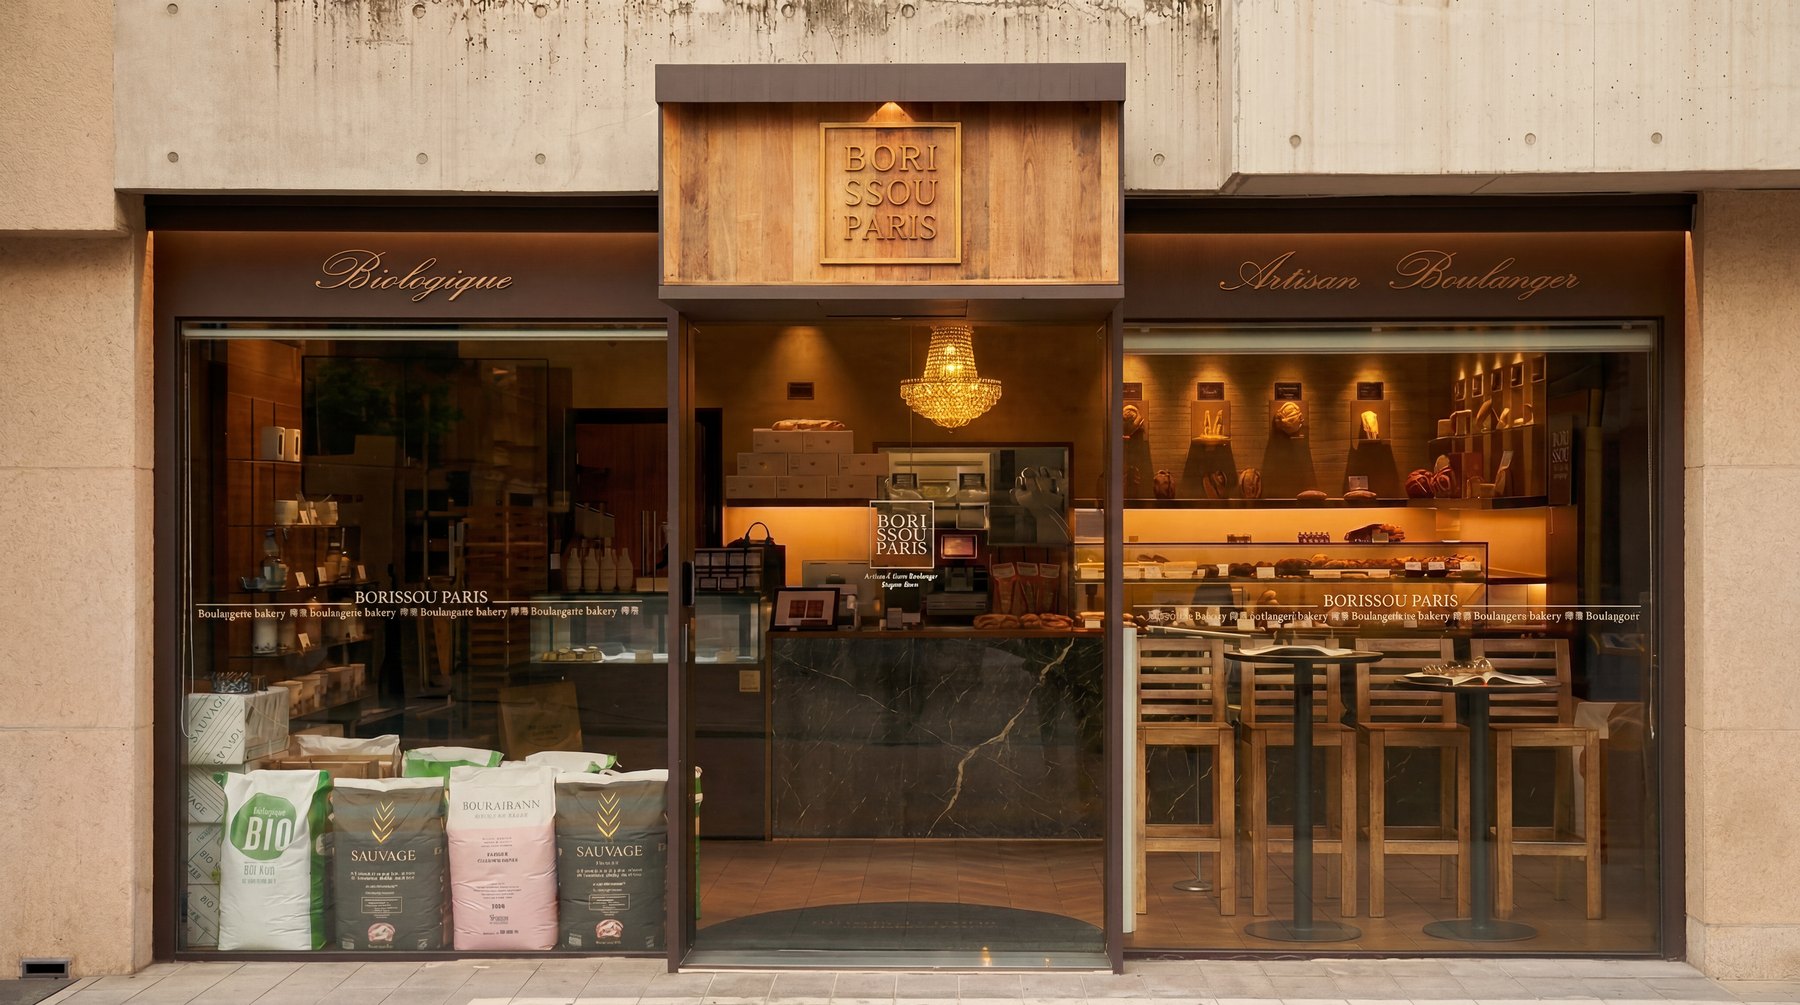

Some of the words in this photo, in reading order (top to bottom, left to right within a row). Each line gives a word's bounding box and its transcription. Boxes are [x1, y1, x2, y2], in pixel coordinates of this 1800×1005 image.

[844, 145, 937, 172] BORI
[844, 179, 938, 206] SSOU
[844, 215, 937, 241] PARIS
[315, 249, 513, 302] Biologique
[1219, 251, 1361, 291] Artisan
[1389, 249, 1581, 301] Boulanger
[877, 514, 926, 528] BORI
[877, 528, 927, 541] SSOU
[876, 541, 928, 555] PARIS
[355, 591, 437, 604] BORISSOU
[442, 591, 489, 604] PARIS
[1323, 594, 1407, 607] BORISSOU
[1412, 594, 1459, 607] PARIS
[254, 609, 286, 621] bakery
[365, 608, 396, 620] bakery
[476, 607, 508, 619] bakery
[586, 606, 617, 618] bakery
[1418, 611, 1450, 623] bakery
[1529, 611, 1562, 623] bakery
[242, 816, 292, 852] BIO
[351, 850, 417, 862] SAUVAGE
[577, 845, 643, 857] SAUVAGE
